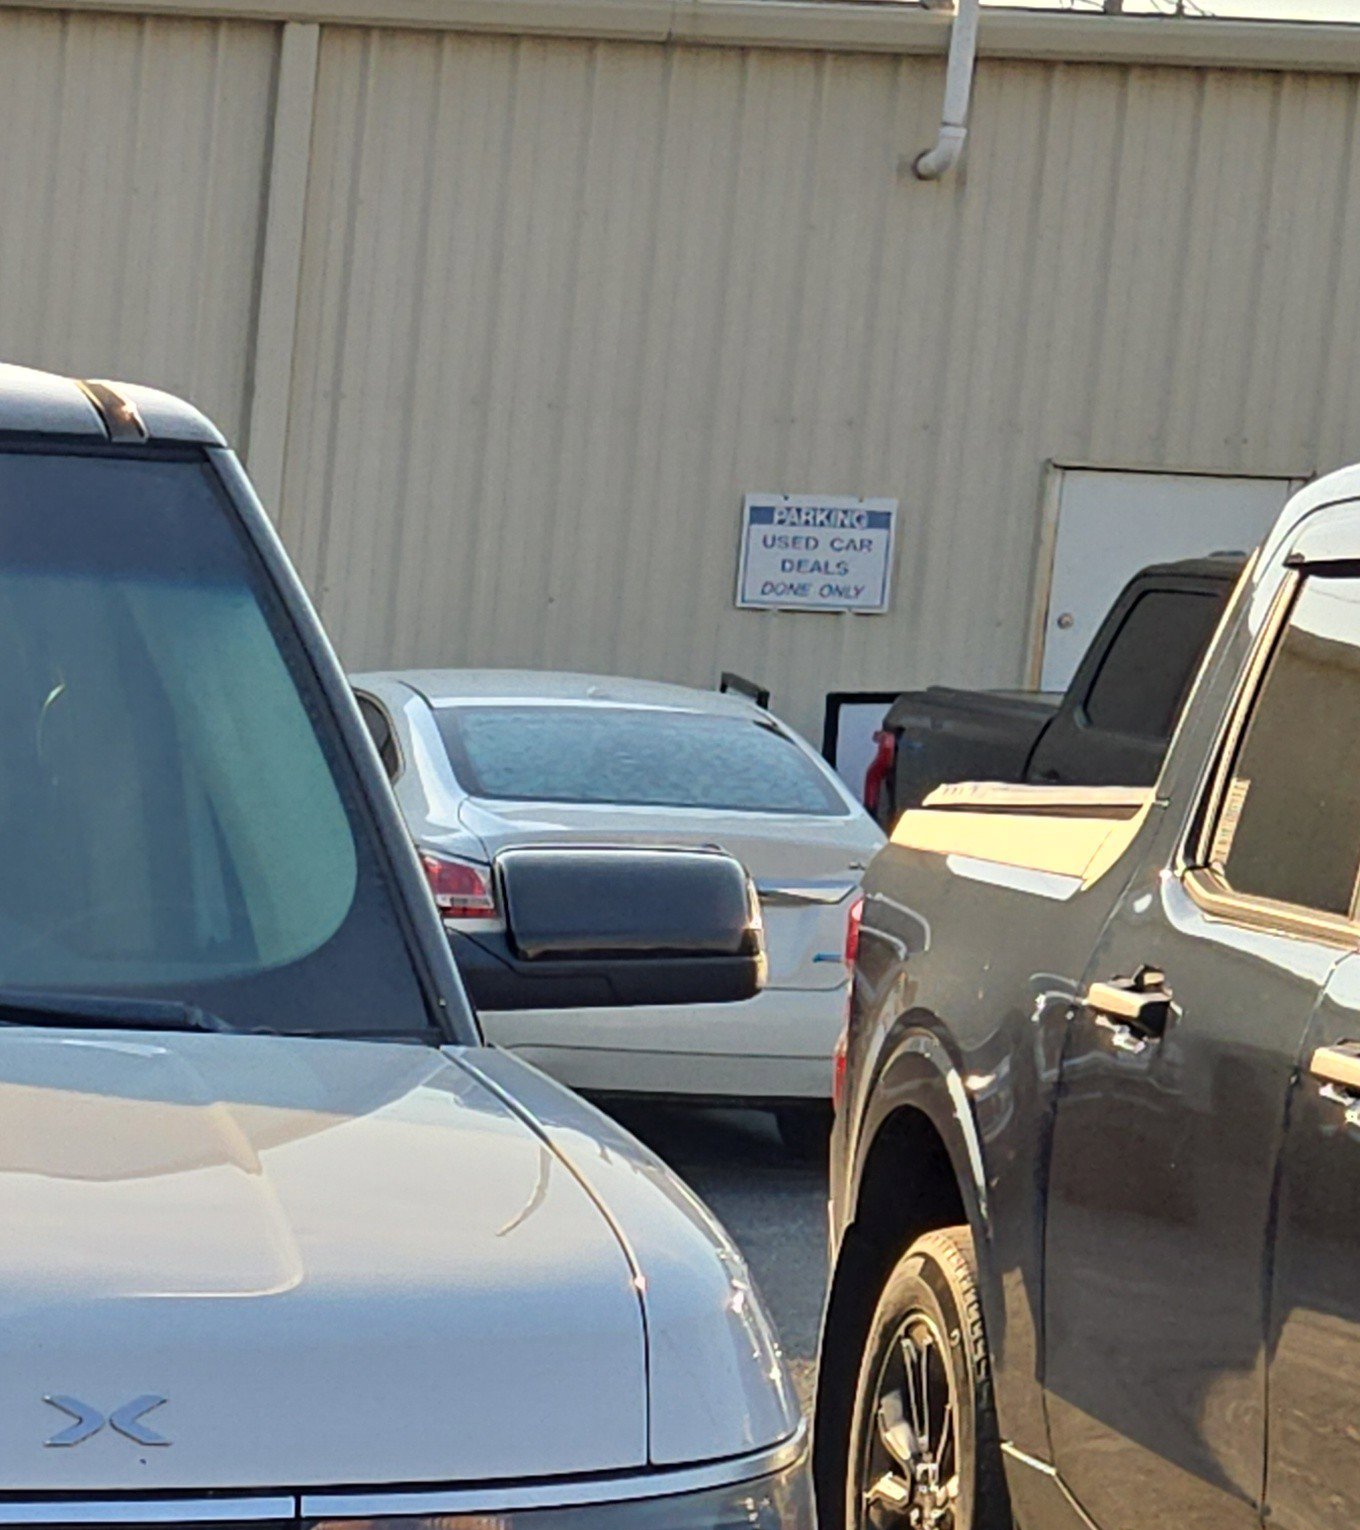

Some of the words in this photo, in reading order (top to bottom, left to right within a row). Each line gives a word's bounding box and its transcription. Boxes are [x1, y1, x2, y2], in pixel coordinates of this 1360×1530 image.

[773, 506, 869, 529] PARKING
[762, 534, 819, 550] USED
[830, 536, 873, 552] CAR
[781, 558, 850, 576] DEALS
[760, 580, 813, 597] DONE
[819, 583, 865, 600] ONLY
